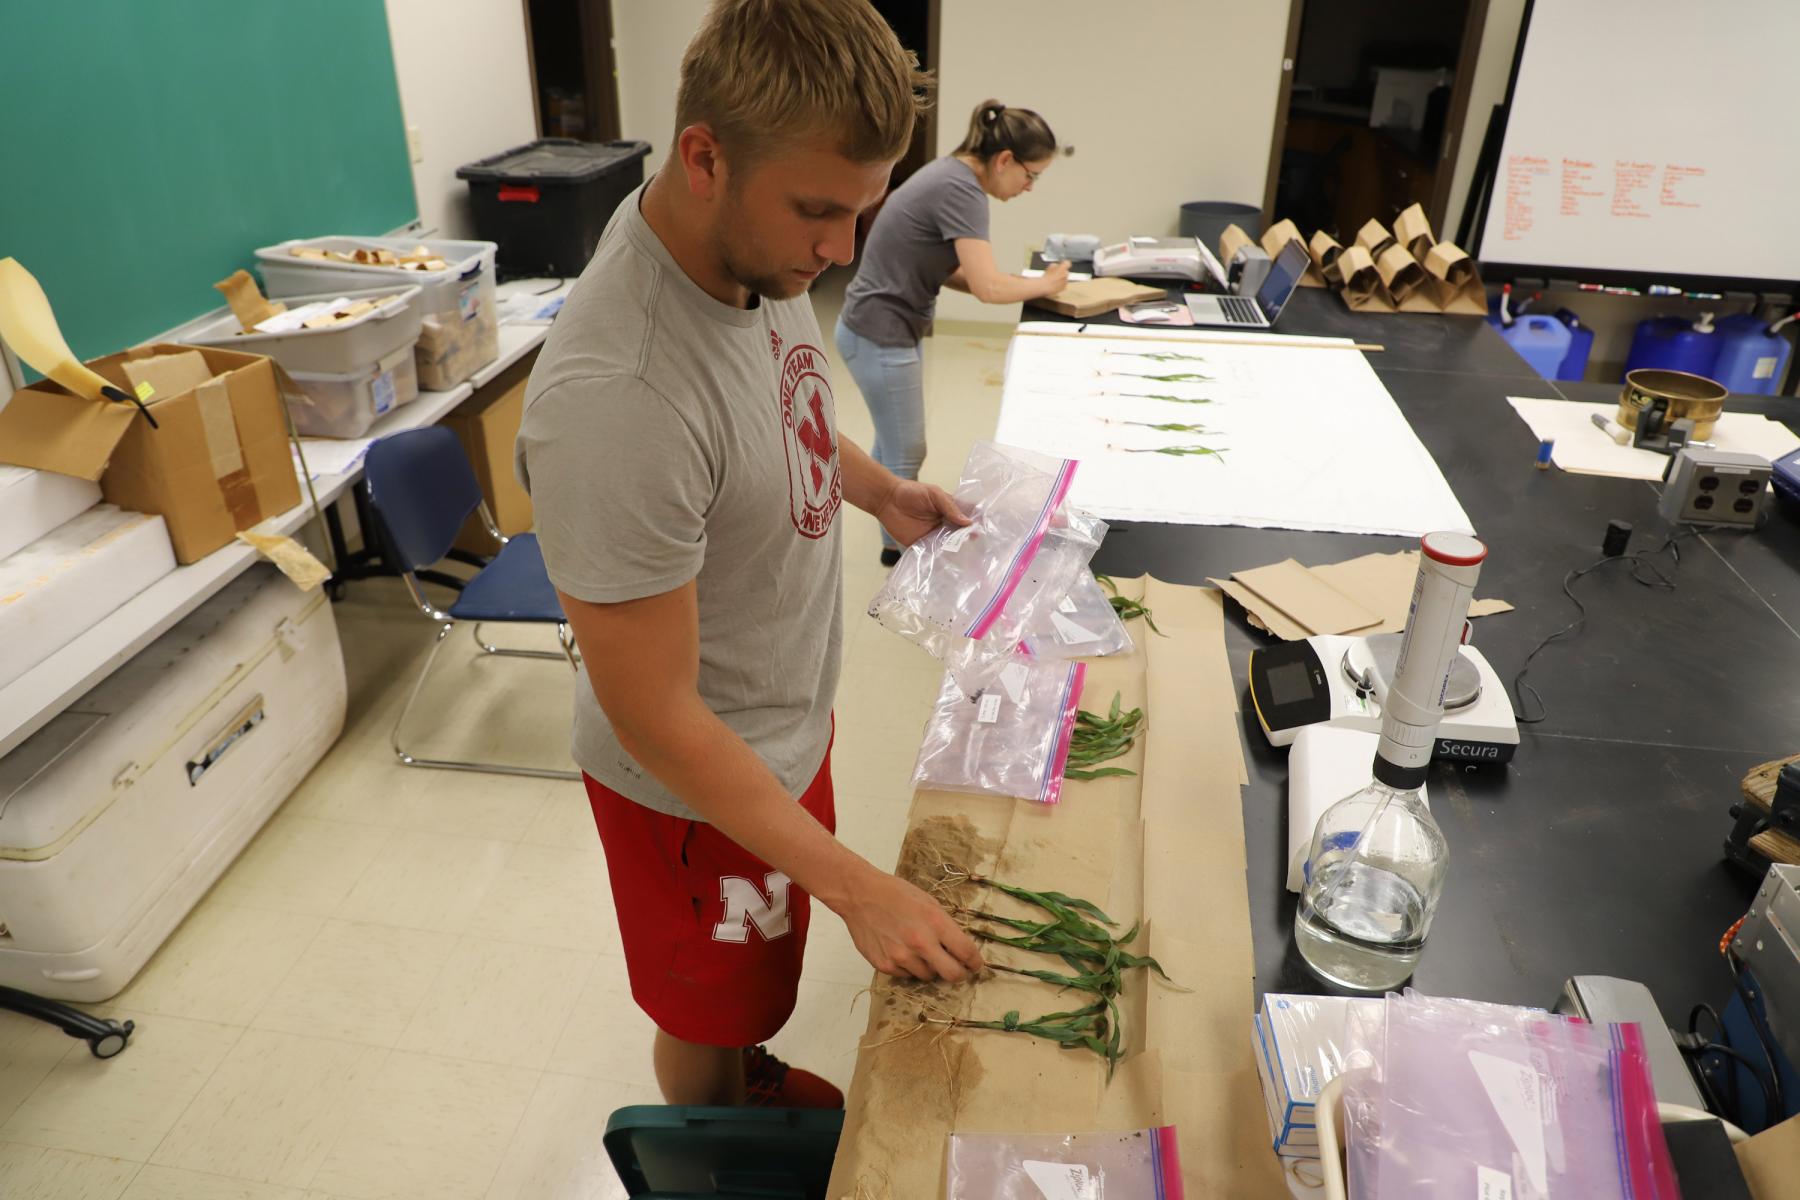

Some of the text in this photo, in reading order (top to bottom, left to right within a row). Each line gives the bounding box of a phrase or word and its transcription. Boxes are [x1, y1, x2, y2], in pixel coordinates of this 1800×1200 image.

[786, 352, 814, 383] TEAM
[1440, 740, 1498, 757] Secura
[712, 870, 792, 944] N
